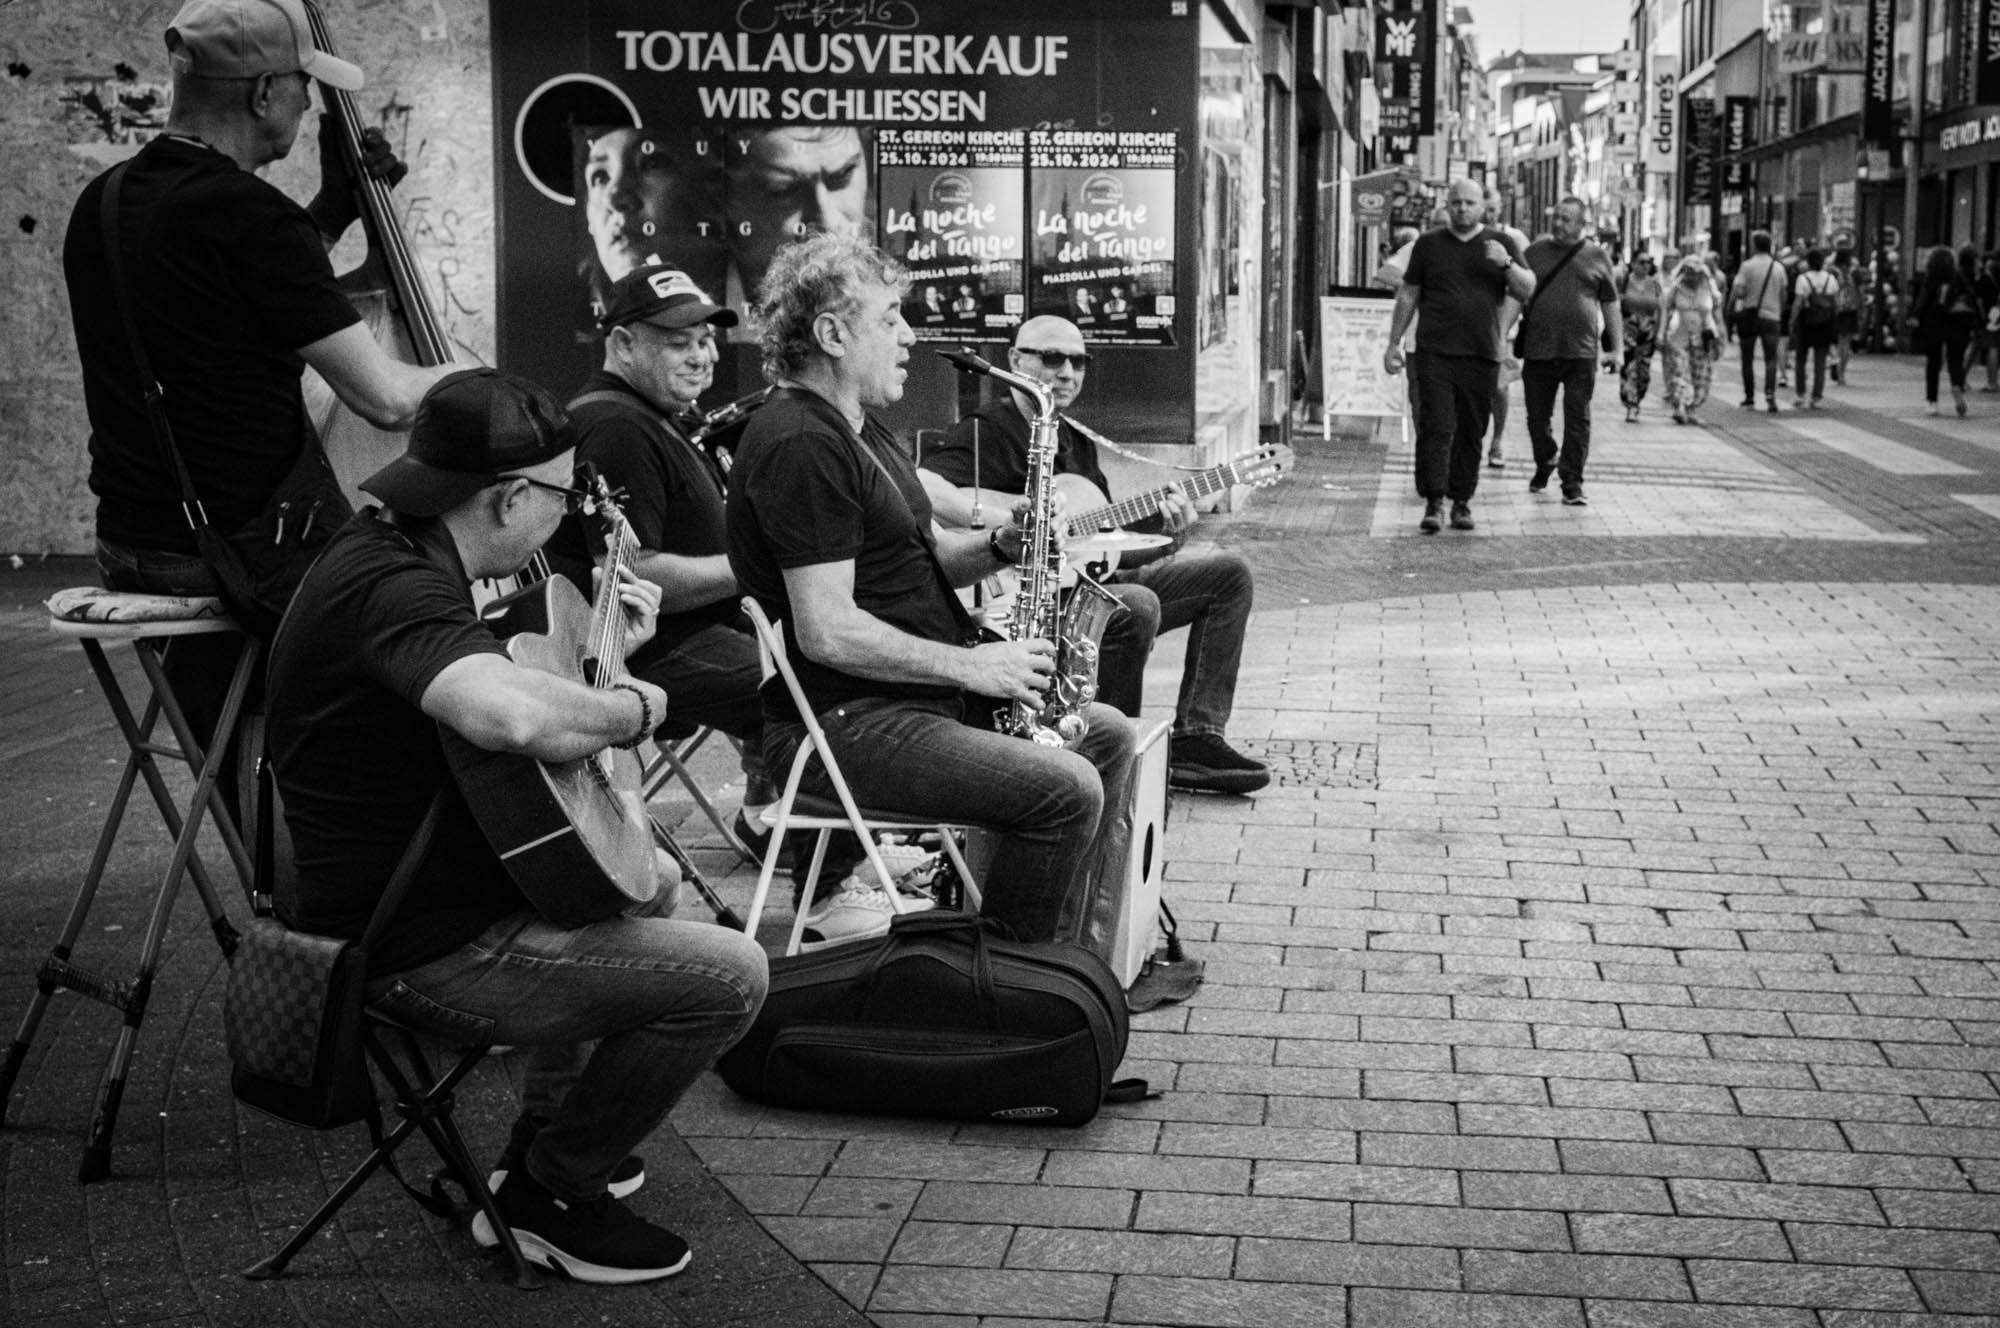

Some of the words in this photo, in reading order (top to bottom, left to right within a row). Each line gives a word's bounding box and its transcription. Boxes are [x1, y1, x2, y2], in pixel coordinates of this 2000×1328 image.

[1385, 17, 1416, 56] WMF
[616, 30, 1068, 76] TOTALAUSVERKAUF
[698, 86, 772, 120] WIR
[781, 88, 986, 122] SCHLIESSEN
[1652, 73, 1675, 153] claire's
[879, 129, 901, 144] ST.
[902, 130, 965, 144] GEREON
[967, 131, 1024, 146] KIRCHE
[1029, 130, 1052, 146] ST.
[1053, 131, 1117, 146] GEREON
[1118, 132, 1176, 147] KIRCHE
[880, 151, 968, 166] 25.10.2024
[1030, 153, 1120, 168] 25.10.2024
[886, 207, 916, 234] La
[923, 202, 996, 234] noche
[1037, 209, 1068, 236] La
[1074, 203, 1148, 236] noche
[907, 240, 937, 261] del
[941, 229, 1016, 261] Tango
[1058, 241, 1088, 263] del
[1093, 231, 1167, 262] Tango
[945, 265, 970, 277] UND
[1042, 270, 1097, 285] PIAZZOLLA
[1097, 267, 1121, 279] UND
